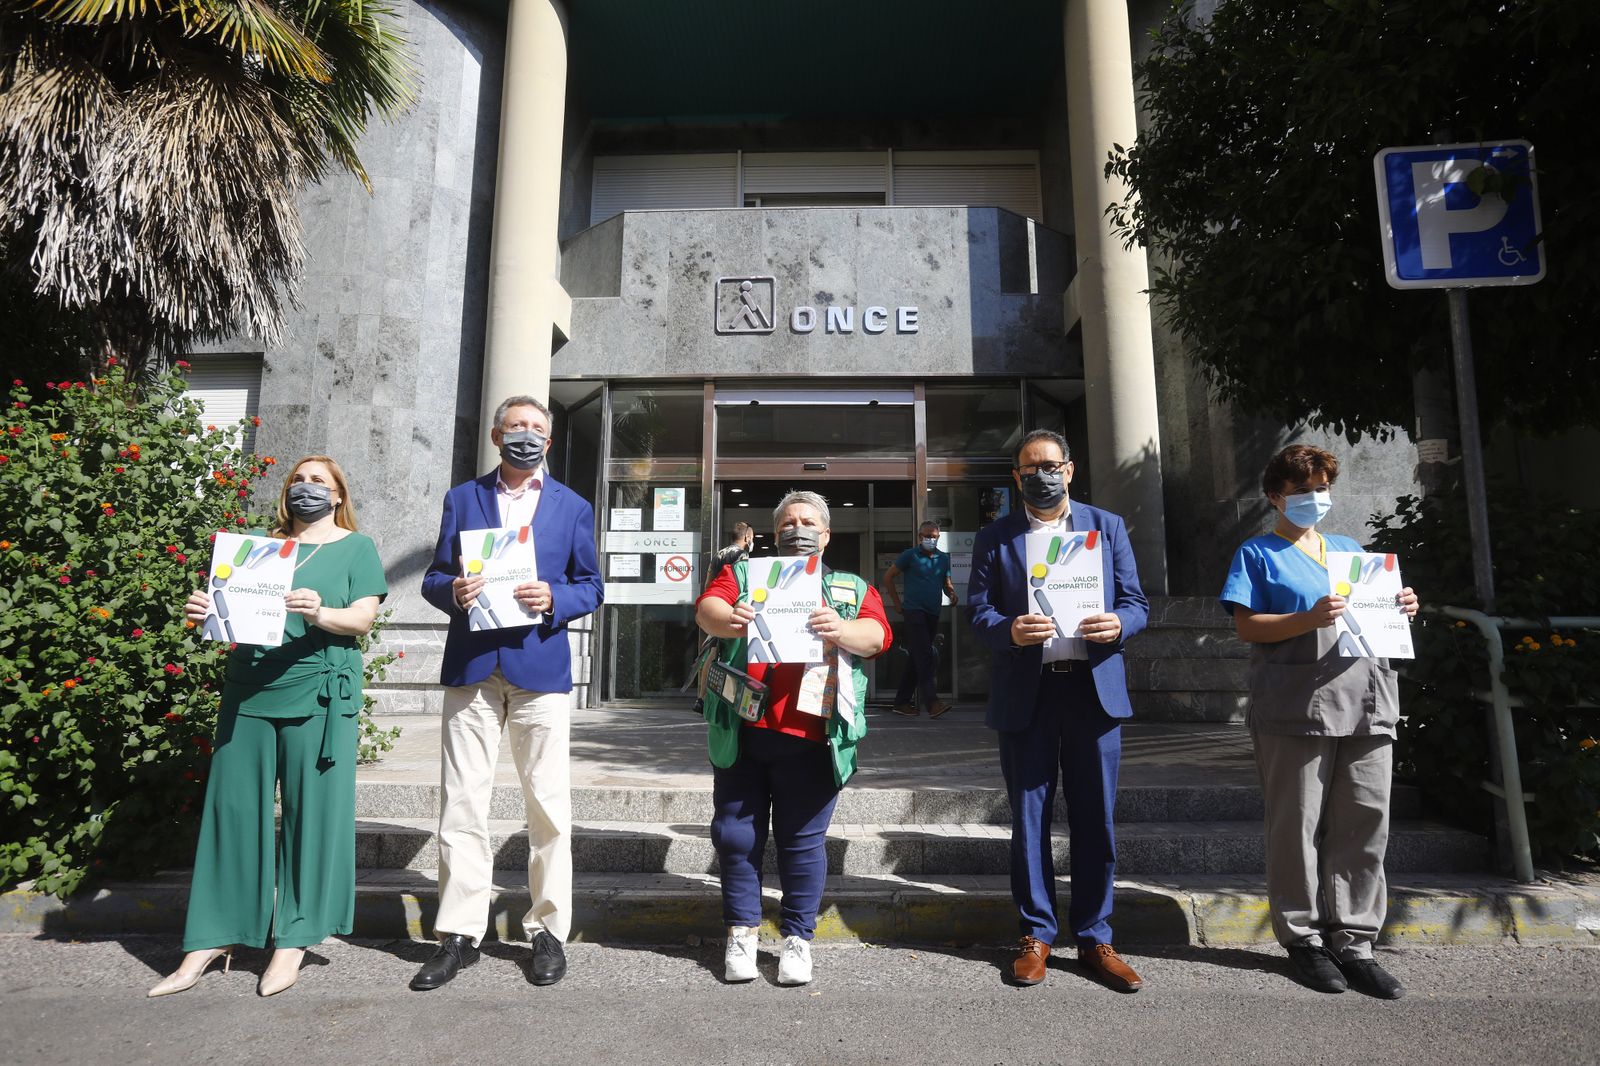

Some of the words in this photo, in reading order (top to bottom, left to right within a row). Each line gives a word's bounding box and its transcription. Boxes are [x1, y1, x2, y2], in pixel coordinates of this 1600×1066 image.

[1411, 158, 1509, 270] P
[791, 305, 919, 334] ONCE
[643, 537, 677, 547] ONCE
[507, 567, 531, 575] VALOR
[257, 582, 286, 591] VALOR
[1047, 582, 1099, 590] COMPARTIDO
[228, 585, 285, 597] COMPARTIDO
[791, 600, 817, 608] VALOR
[261, 610, 281, 618] ONCE
